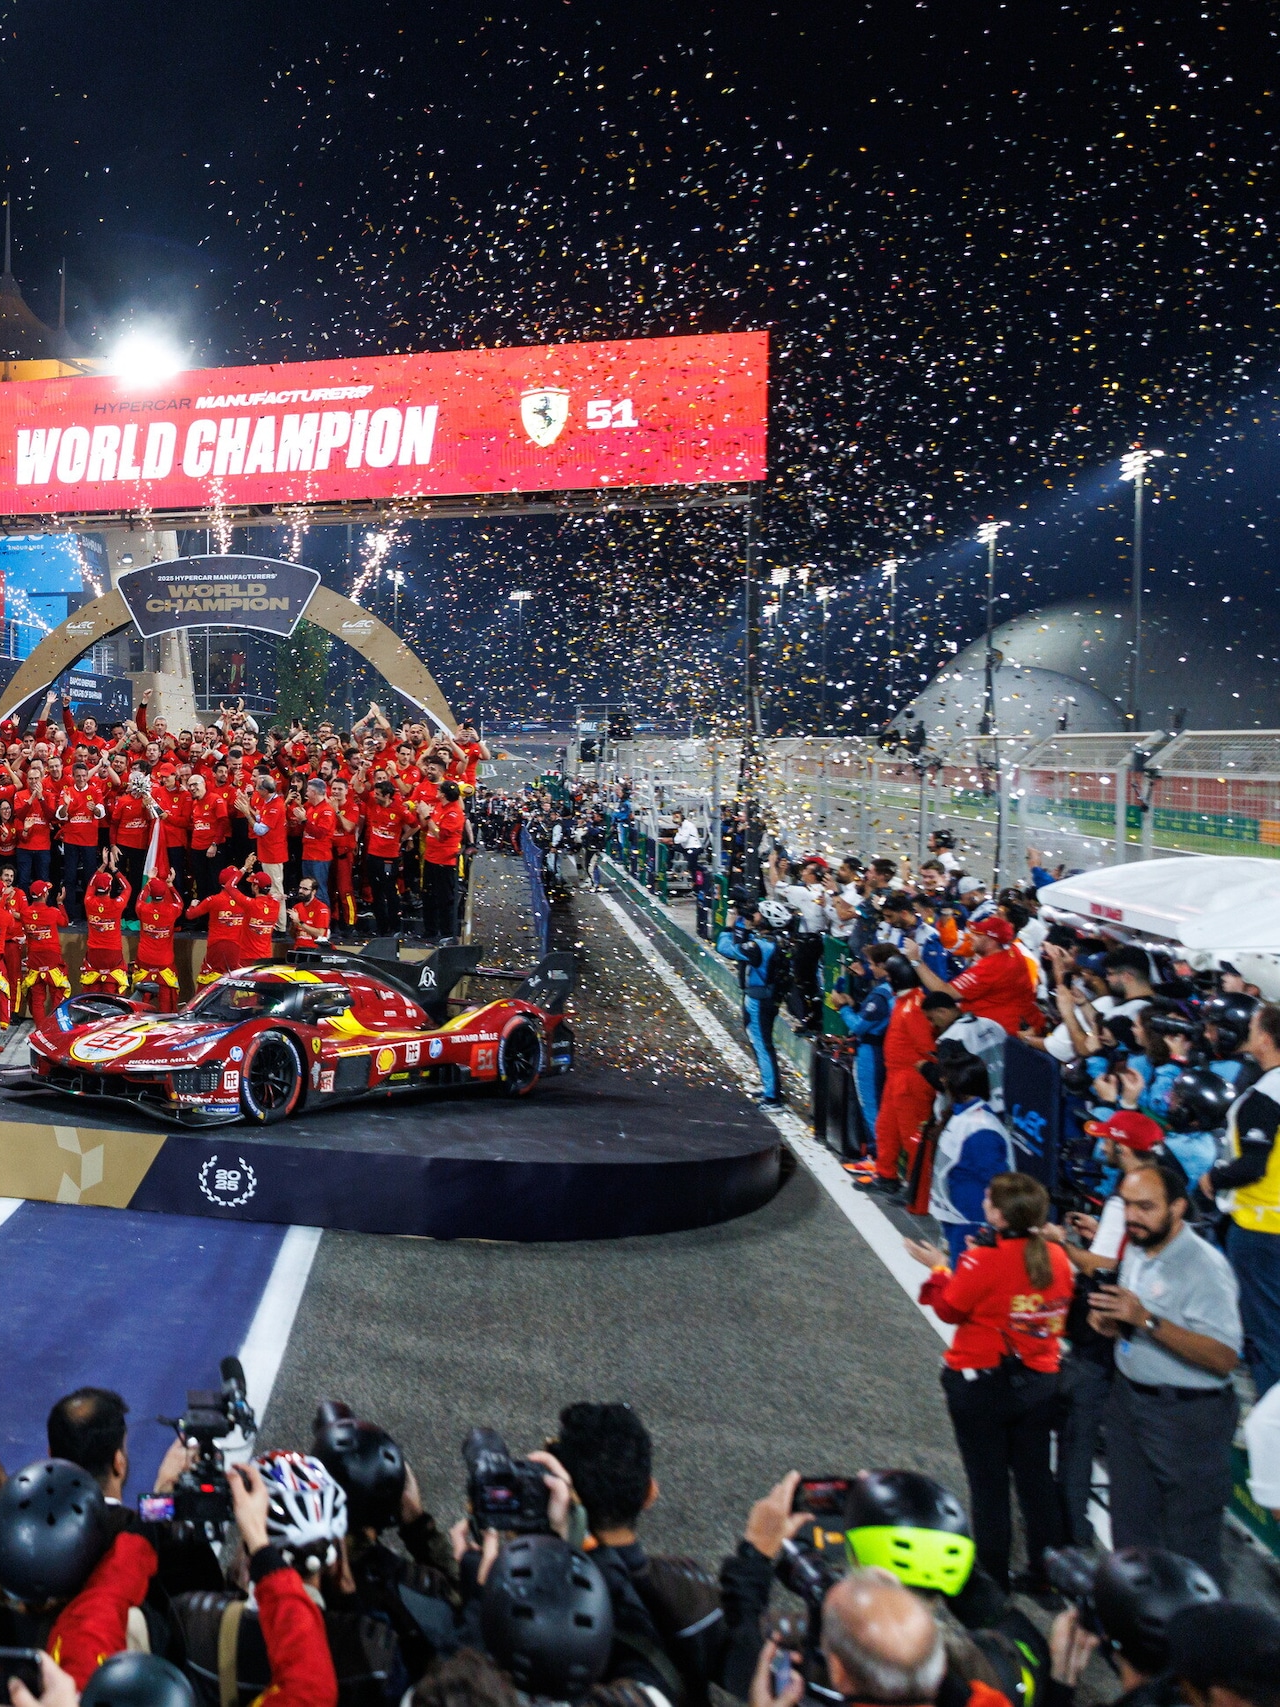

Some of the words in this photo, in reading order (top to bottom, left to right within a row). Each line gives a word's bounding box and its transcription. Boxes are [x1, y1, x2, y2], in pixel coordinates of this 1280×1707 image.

[94, 398, 191, 415] HYPERCAR
[586, 399, 639, 430] 51
[16, 421, 177, 486] WORLD
[182, 405, 440, 478] CHAMPION
[174, 574, 213, 582] HYPERCAR
[168, 583, 267, 598] WORLD
[146, 597, 290, 613] CHAMPION
[88, 1034, 132, 1049] 51
[451, 1033, 479, 1043] RICHARD
[479, 1032, 499, 1041] MILLE
[477, 1048, 493, 1070] 51
[178, 1095, 213, 1104] V-Power
[215, 1168, 241, 1181] 20
[214, 1179, 239, 1191] 25
